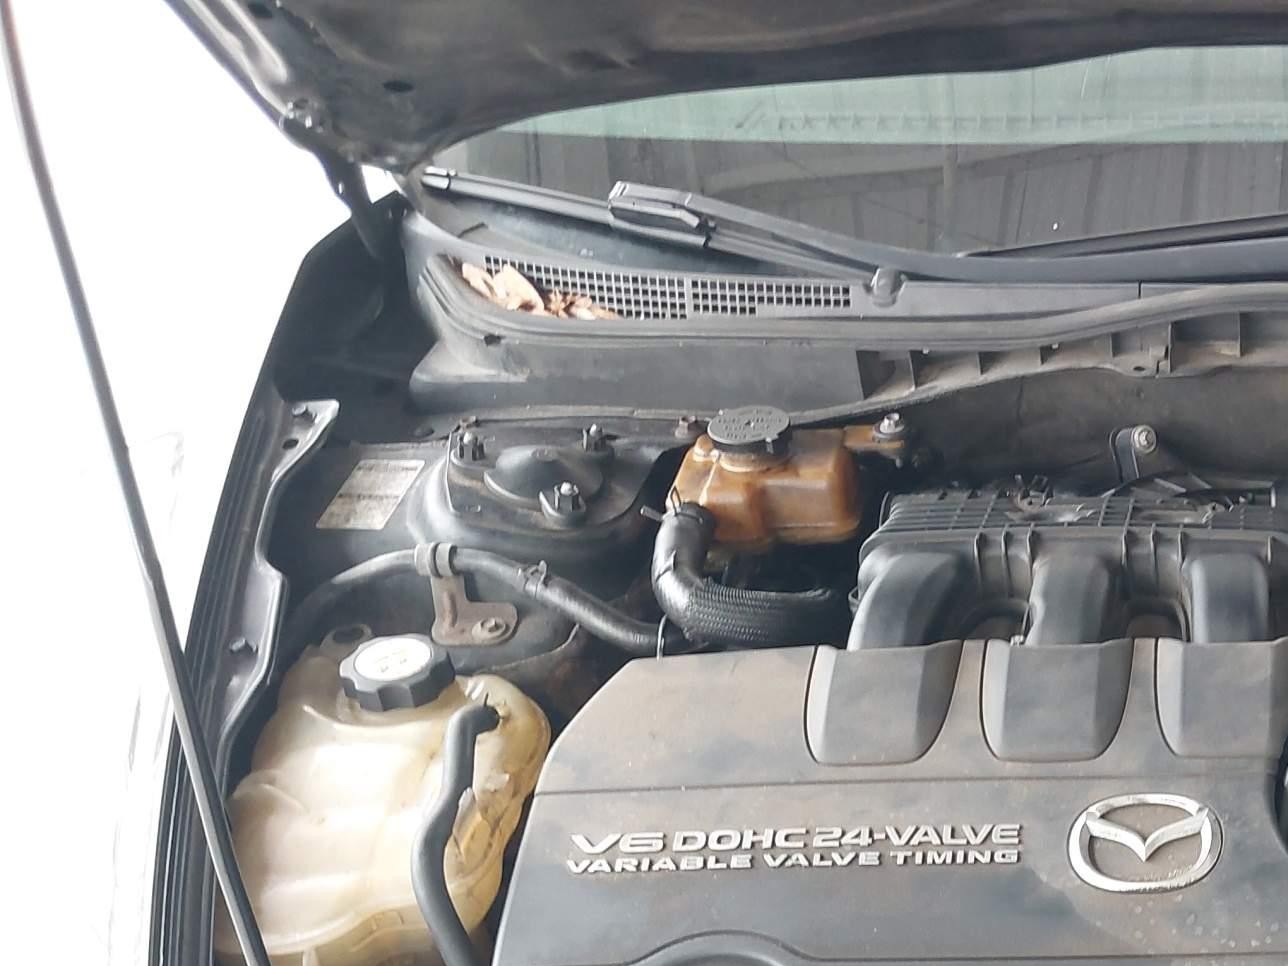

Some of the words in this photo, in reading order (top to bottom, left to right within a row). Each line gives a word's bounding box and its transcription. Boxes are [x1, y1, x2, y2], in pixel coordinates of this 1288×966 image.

[571, 831, 665, 854] V6
[672, 828, 807, 852] DOHC
[813, 824, 1021, 848] 24-VALVE
[566, 853, 753, 874] VARIABLE
[763, 851, 881, 868] VALVE
[889, 850, 1020, 865] TIMING
